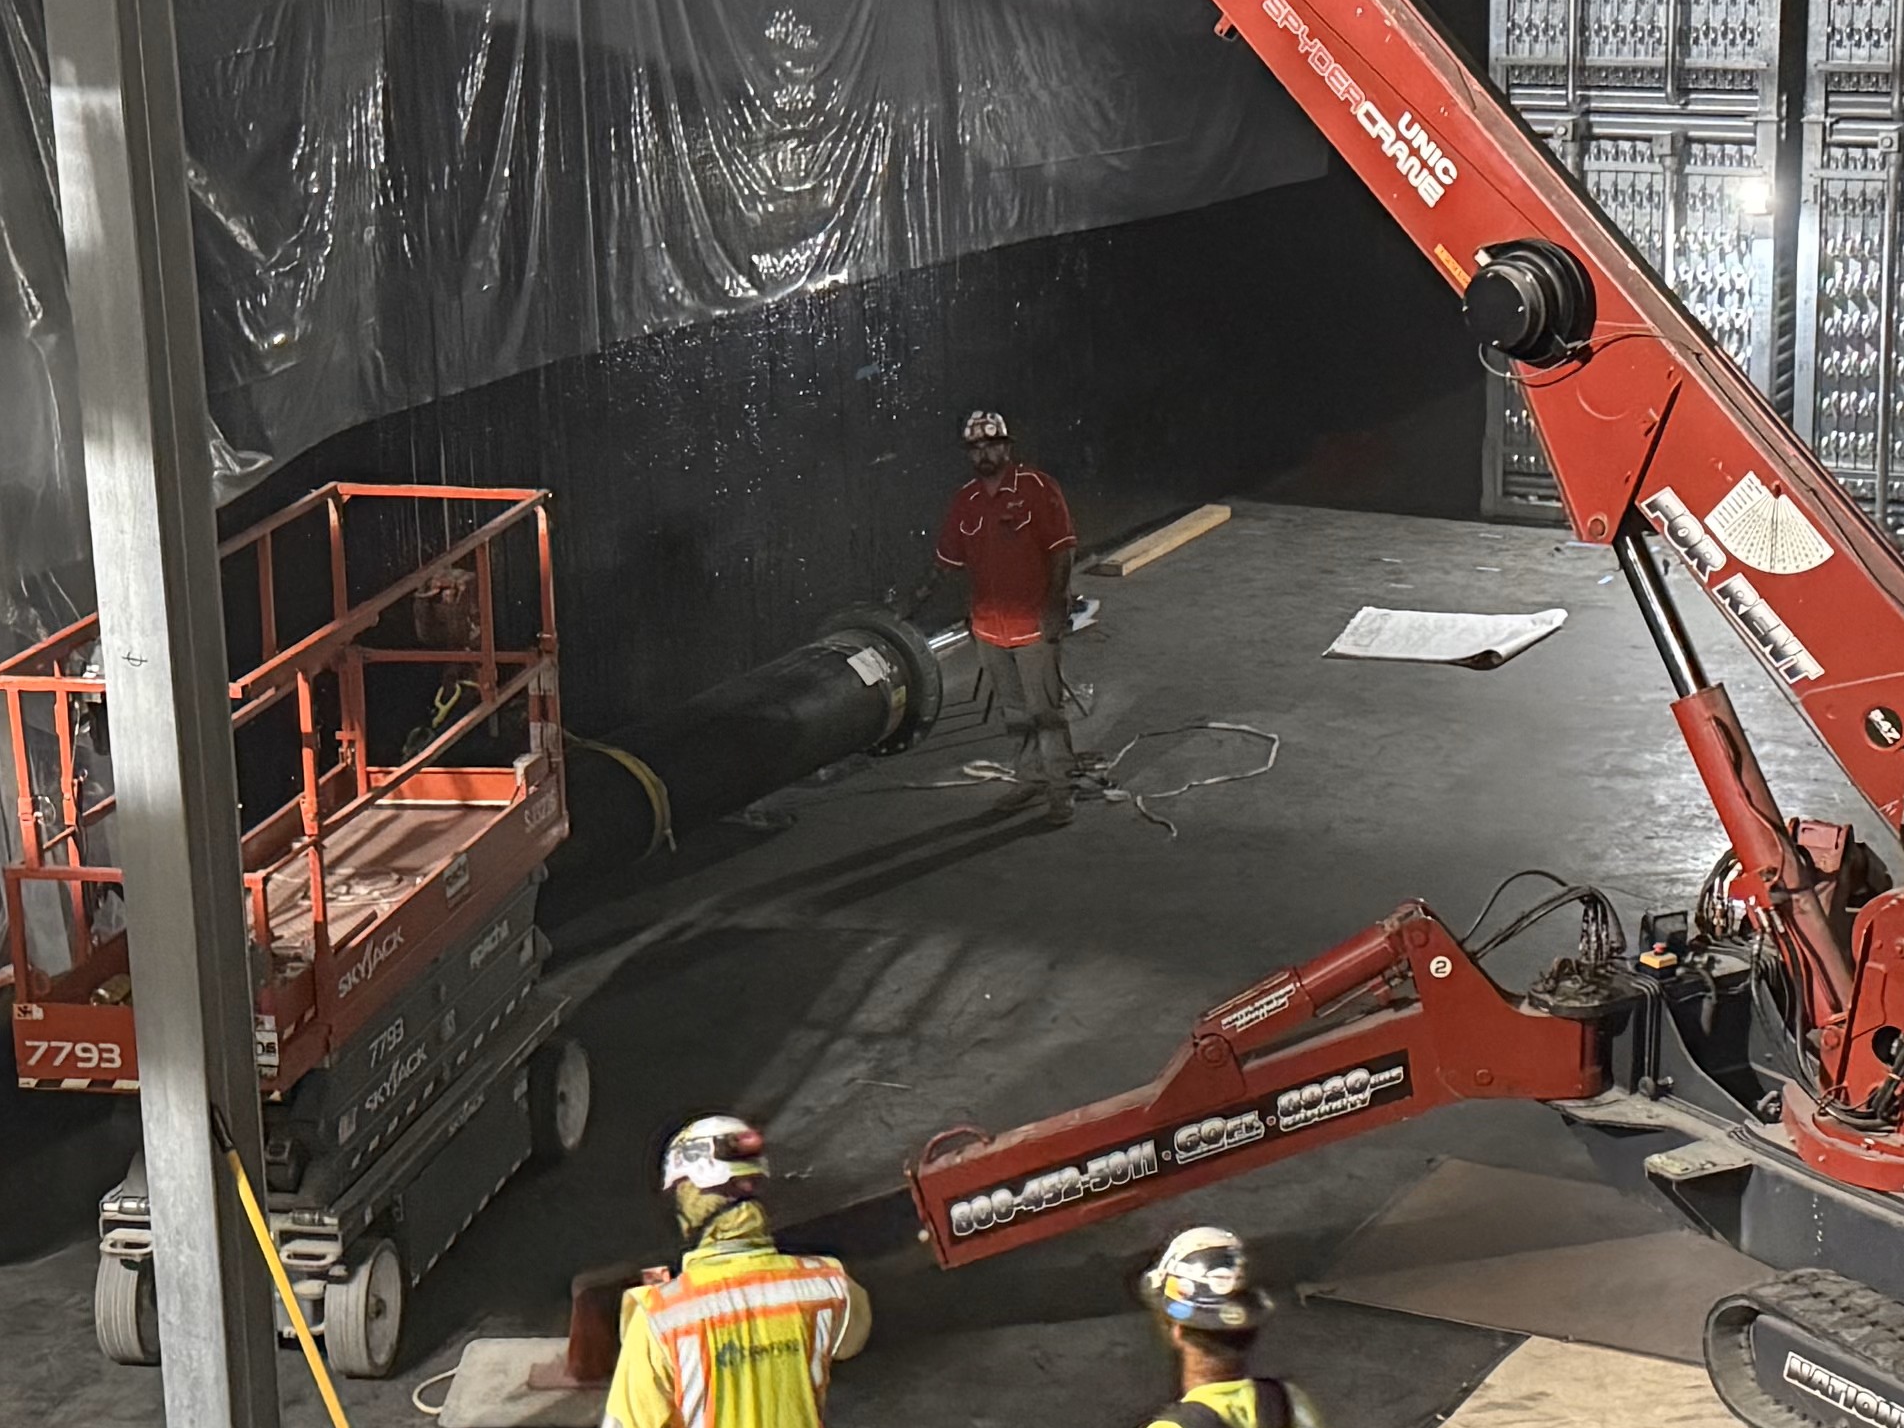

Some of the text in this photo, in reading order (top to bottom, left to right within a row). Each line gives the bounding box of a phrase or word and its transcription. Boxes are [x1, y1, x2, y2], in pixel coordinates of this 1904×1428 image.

[1398, 111, 1458, 185] UNIC
[1641, 486, 1727, 583] FOR
[1712, 572, 1826, 684] RENT
[1435, 960, 1447, 974] 2
[24, 1040, 122, 1069] 7793
[950, 1139, 1159, 1237] 800-452-5011
